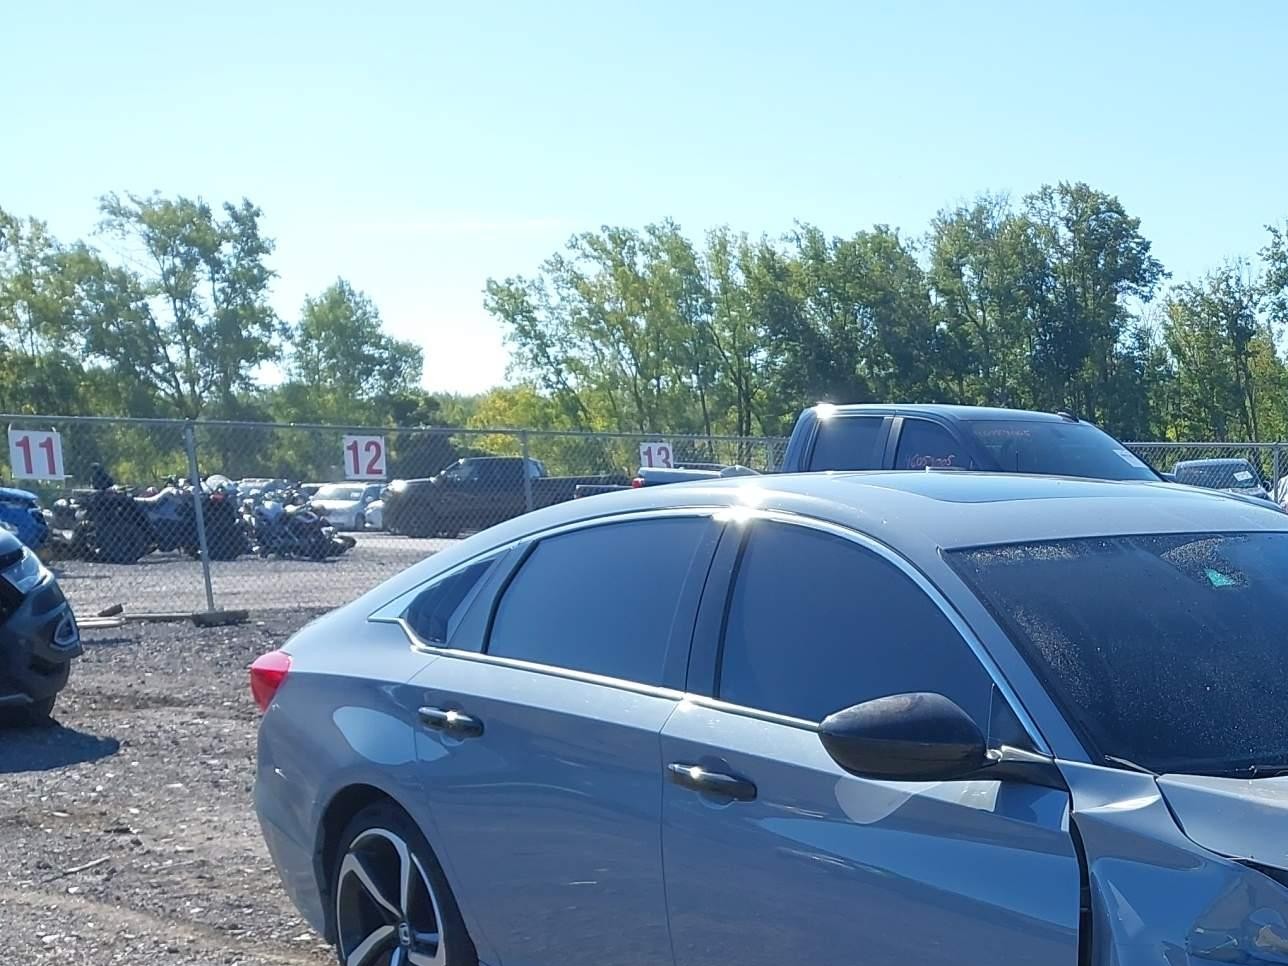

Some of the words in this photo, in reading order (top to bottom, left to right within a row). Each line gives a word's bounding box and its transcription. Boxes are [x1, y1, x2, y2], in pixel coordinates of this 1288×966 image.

[15, 435, 57, 475] 11
[346, 440, 383, 475] 12
[642, 446, 672, 468] 13
